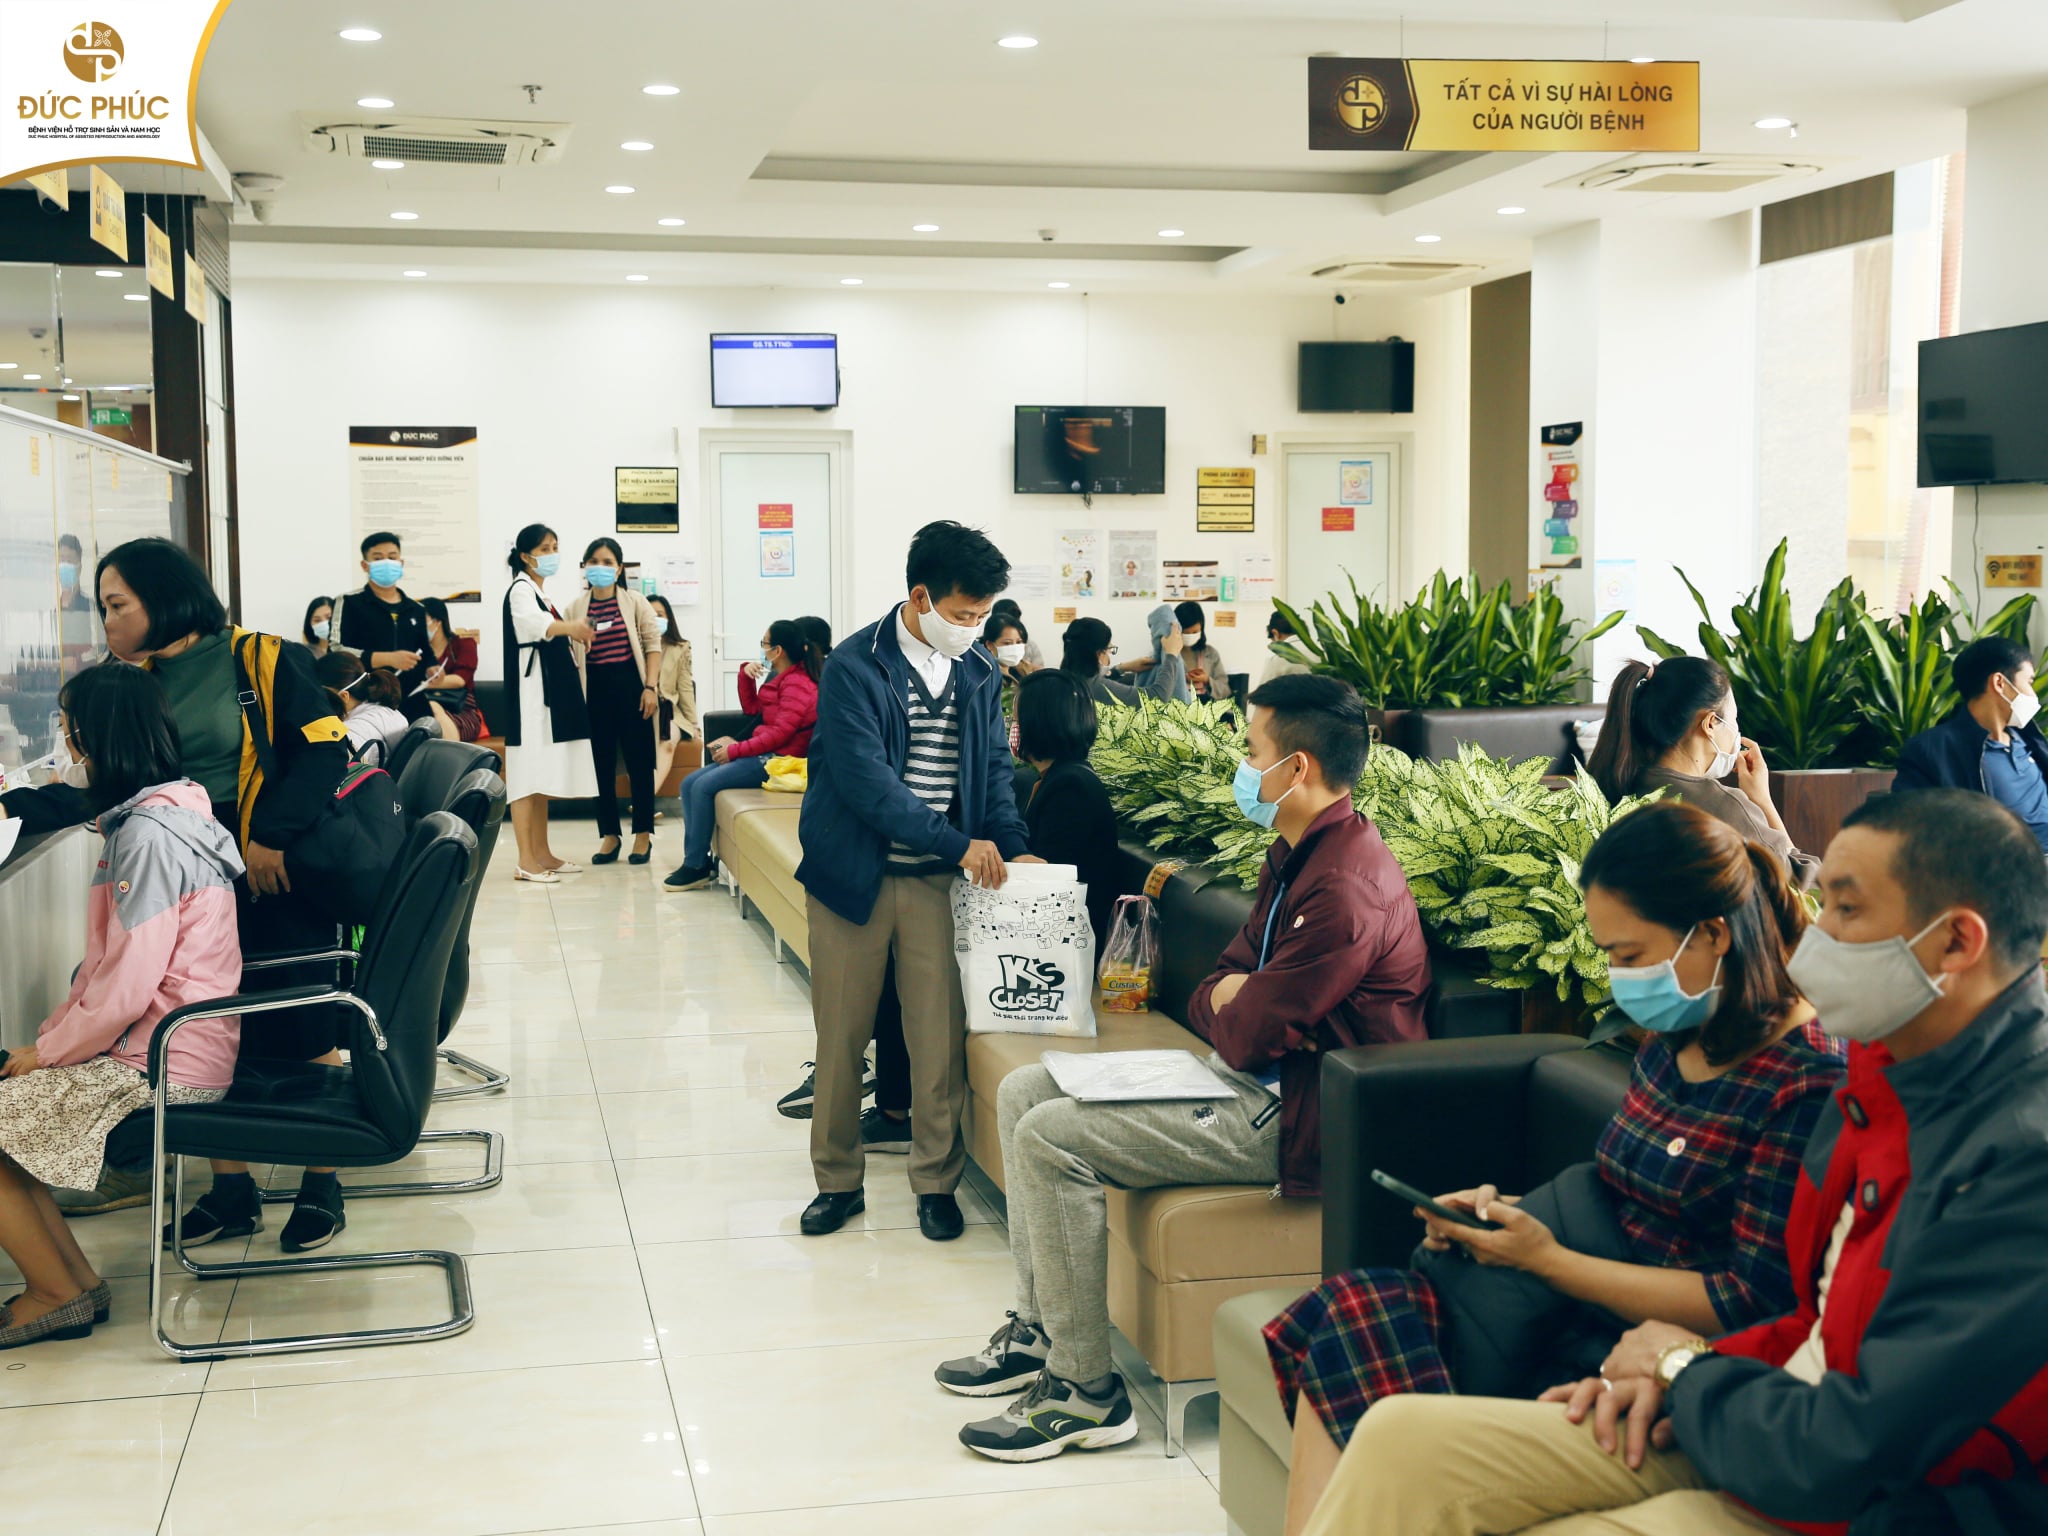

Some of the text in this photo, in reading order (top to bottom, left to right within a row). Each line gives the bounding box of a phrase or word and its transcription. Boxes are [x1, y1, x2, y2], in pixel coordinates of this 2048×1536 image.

[1443, 77, 1673, 107] TẤT CẢ VÌ SỰ HÀI LÒNG
[1473, 108, 1645, 135] CỦA NGƯỜI BỆNH
